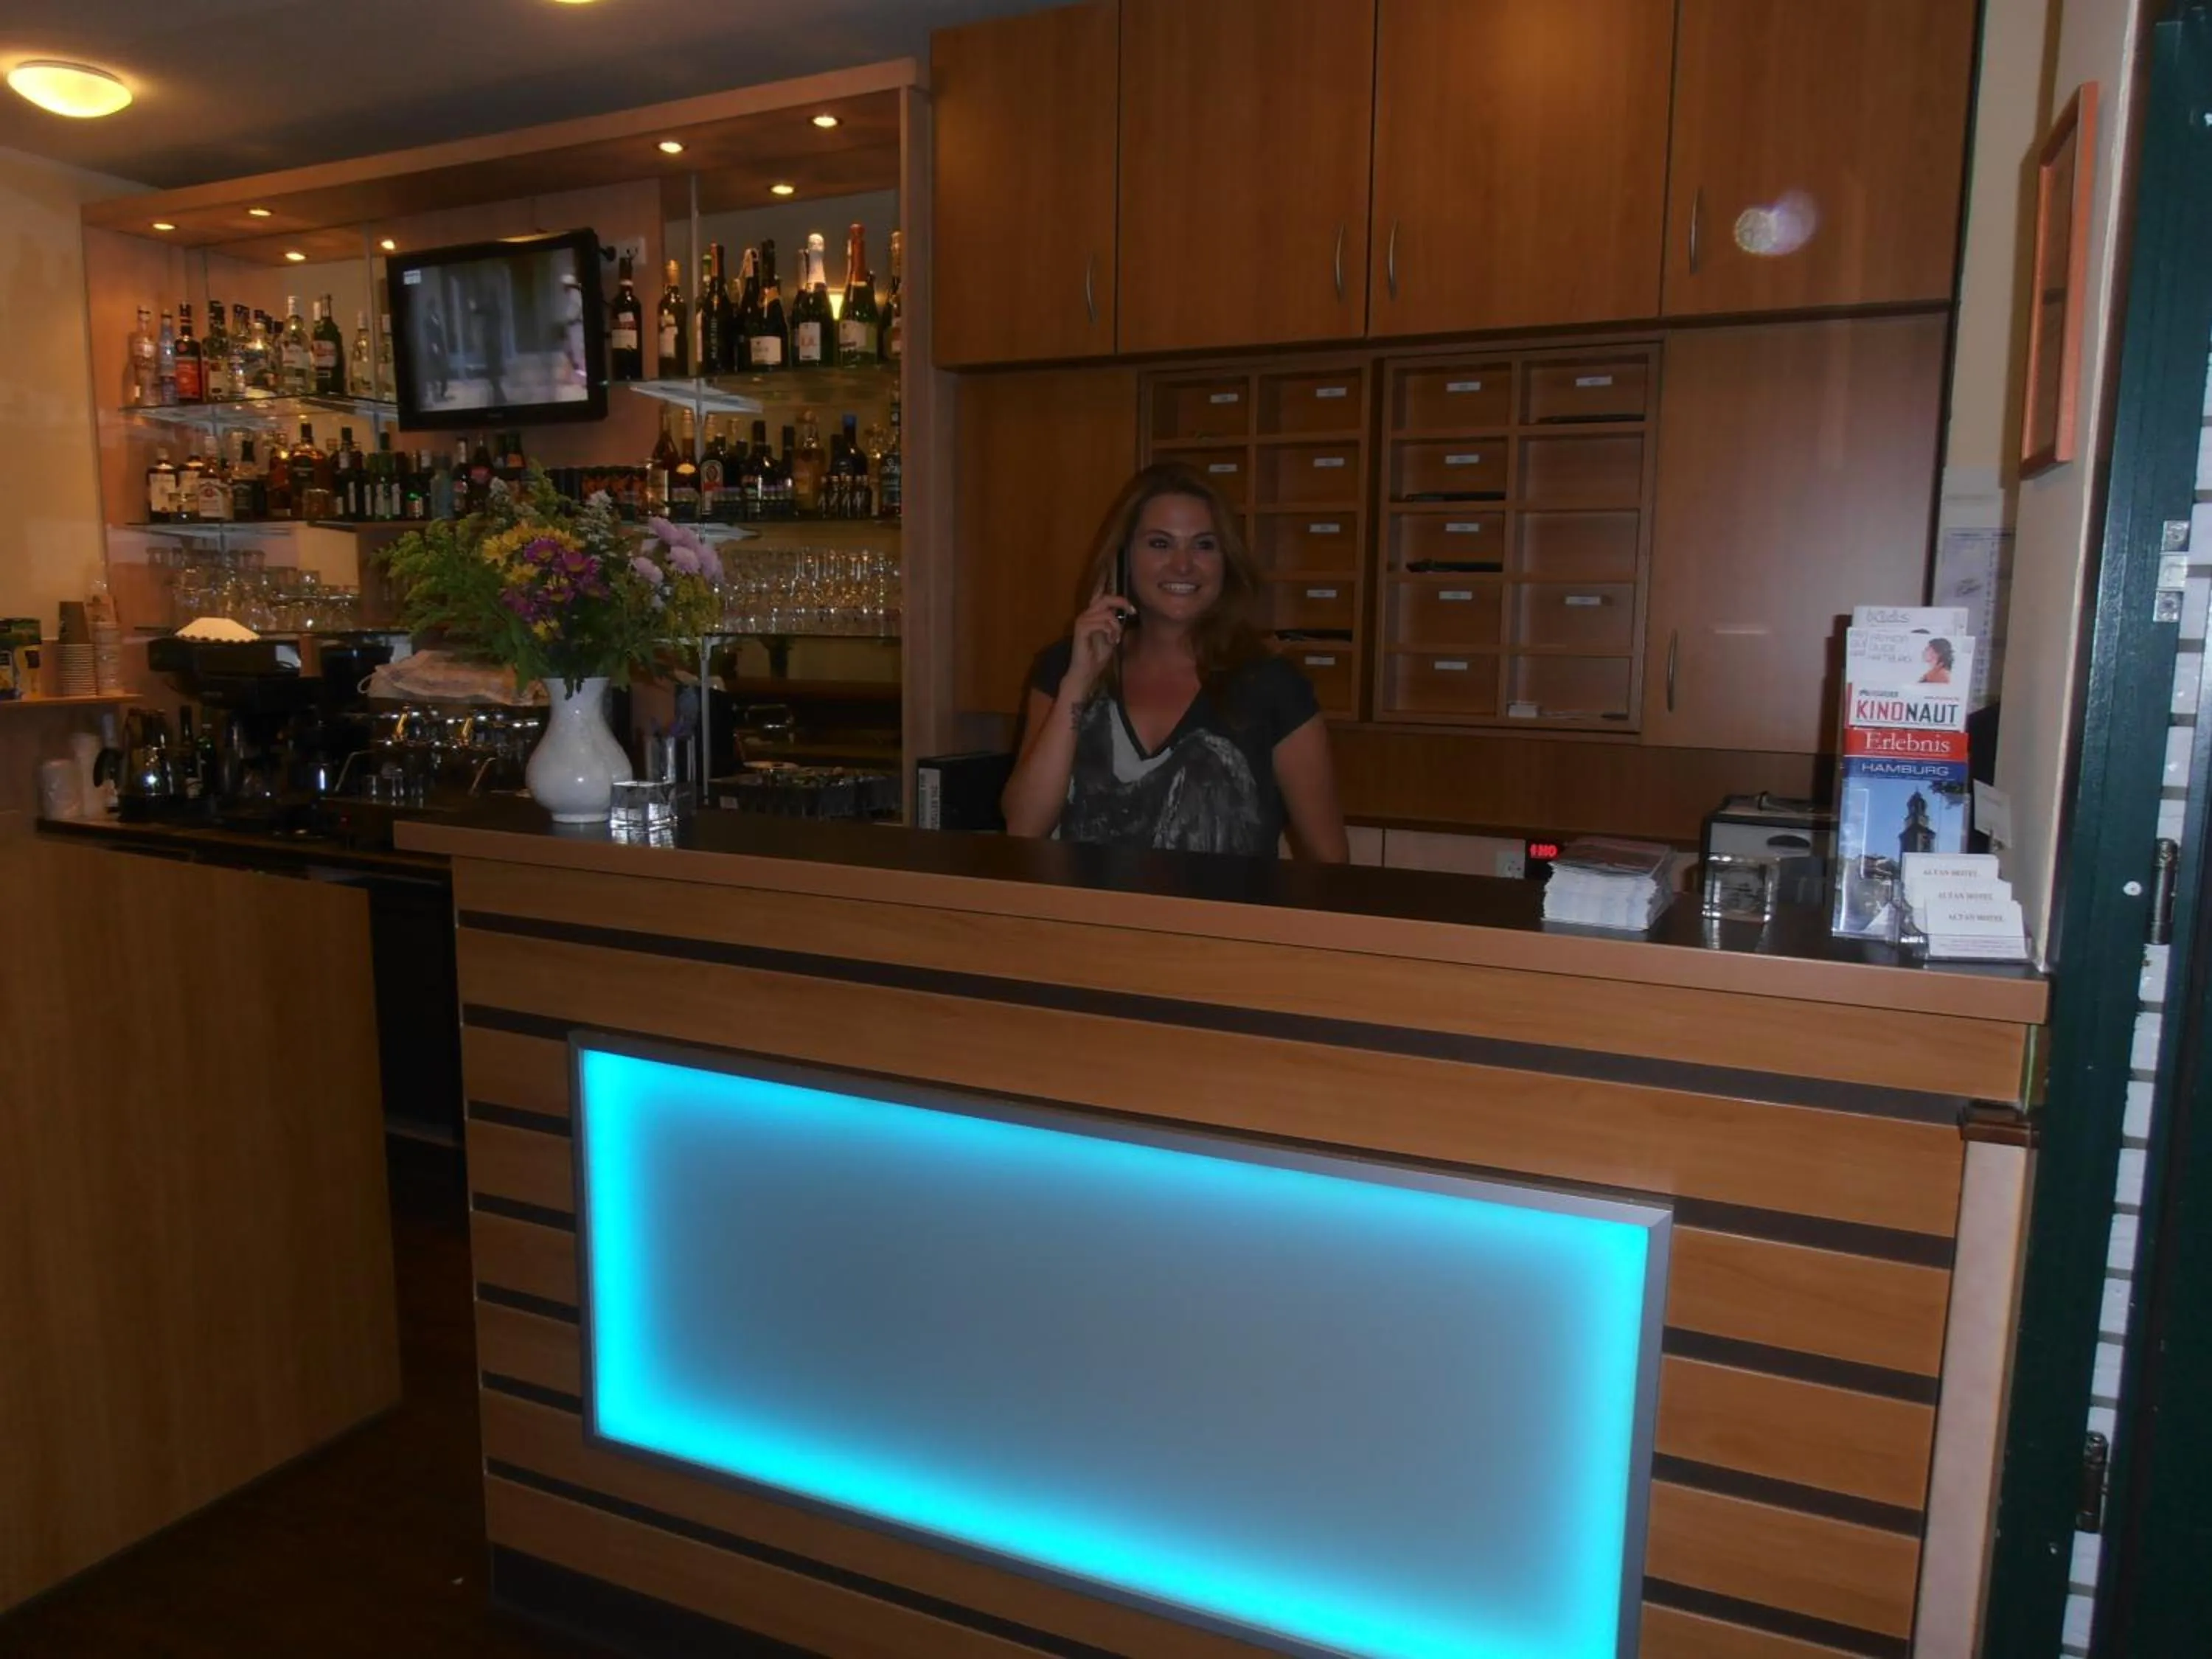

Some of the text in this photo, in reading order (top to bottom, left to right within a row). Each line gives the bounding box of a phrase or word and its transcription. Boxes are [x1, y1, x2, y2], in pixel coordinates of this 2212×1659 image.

[1864, 731, 1951, 753] Erlebnis
[1861, 762, 1950, 776] HAMBURG
[1951, 869, 1978, 878] HOTEL
[1966, 891, 1994, 901] HOTEL
